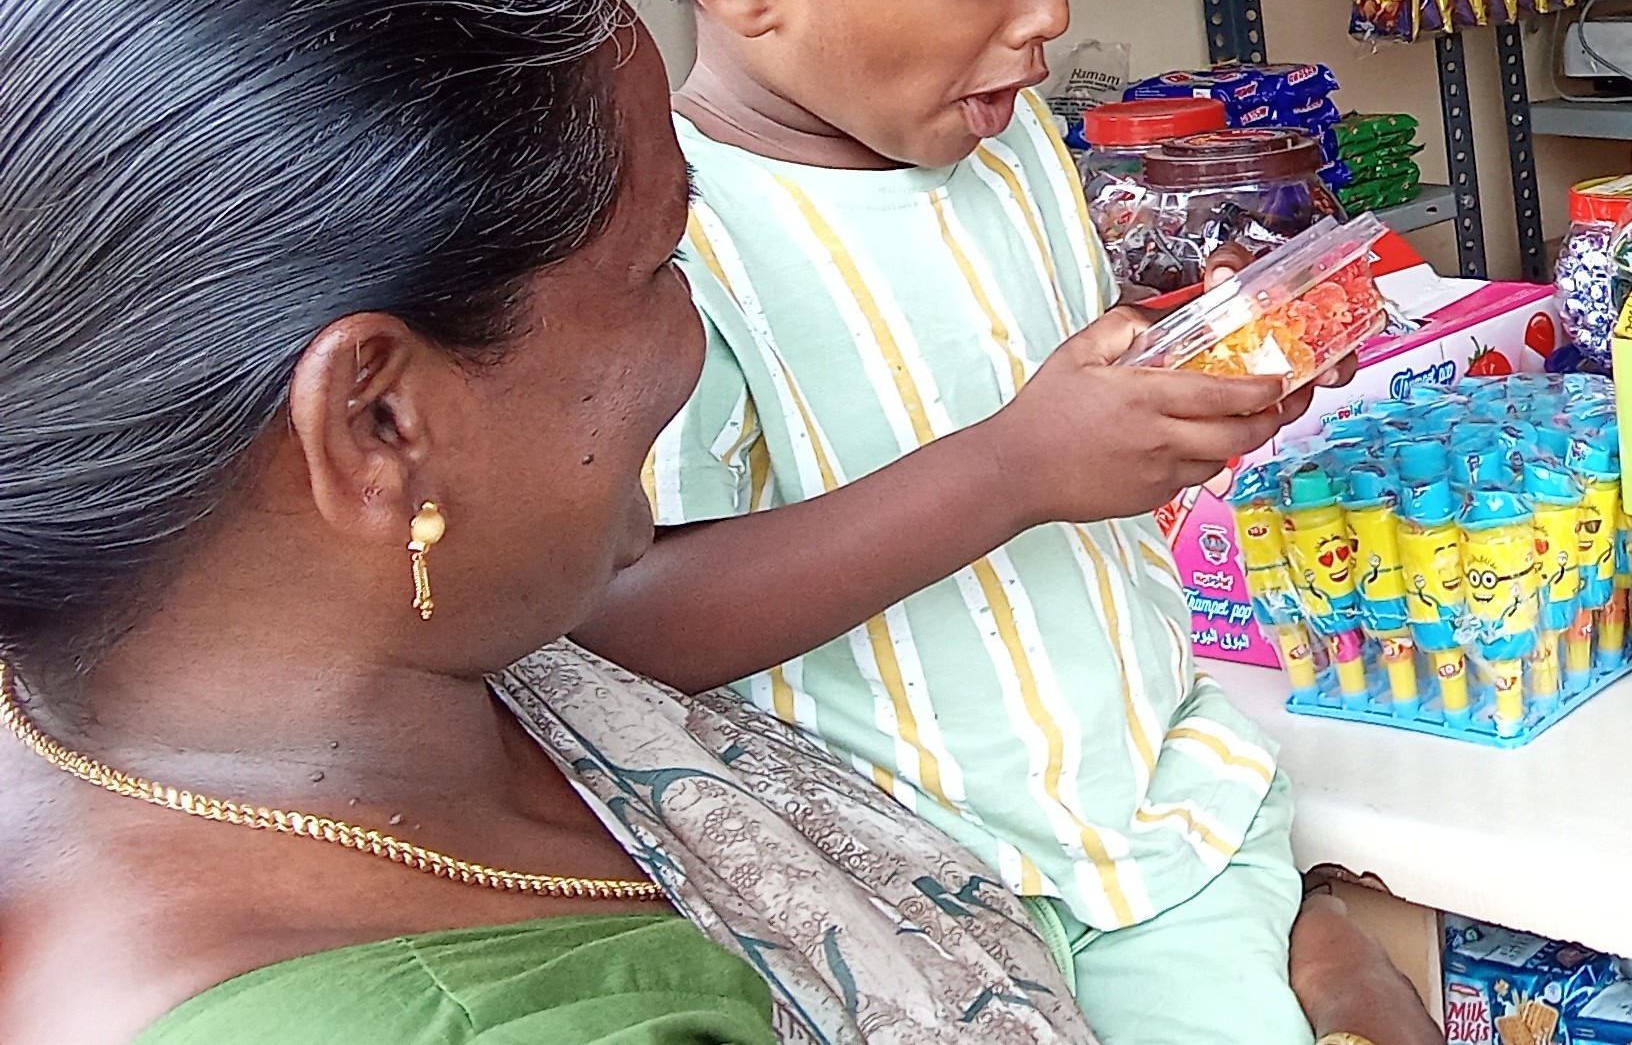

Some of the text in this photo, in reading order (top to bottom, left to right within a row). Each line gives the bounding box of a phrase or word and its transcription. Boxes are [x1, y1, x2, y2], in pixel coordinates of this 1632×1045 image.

[1071, 68, 1121, 87] Hamam
[1183, 586, 1253, 626] Trumpet pop
[1450, 1001, 1488, 1023] Milk
[1446, 1021, 1490, 1043] Bikis
